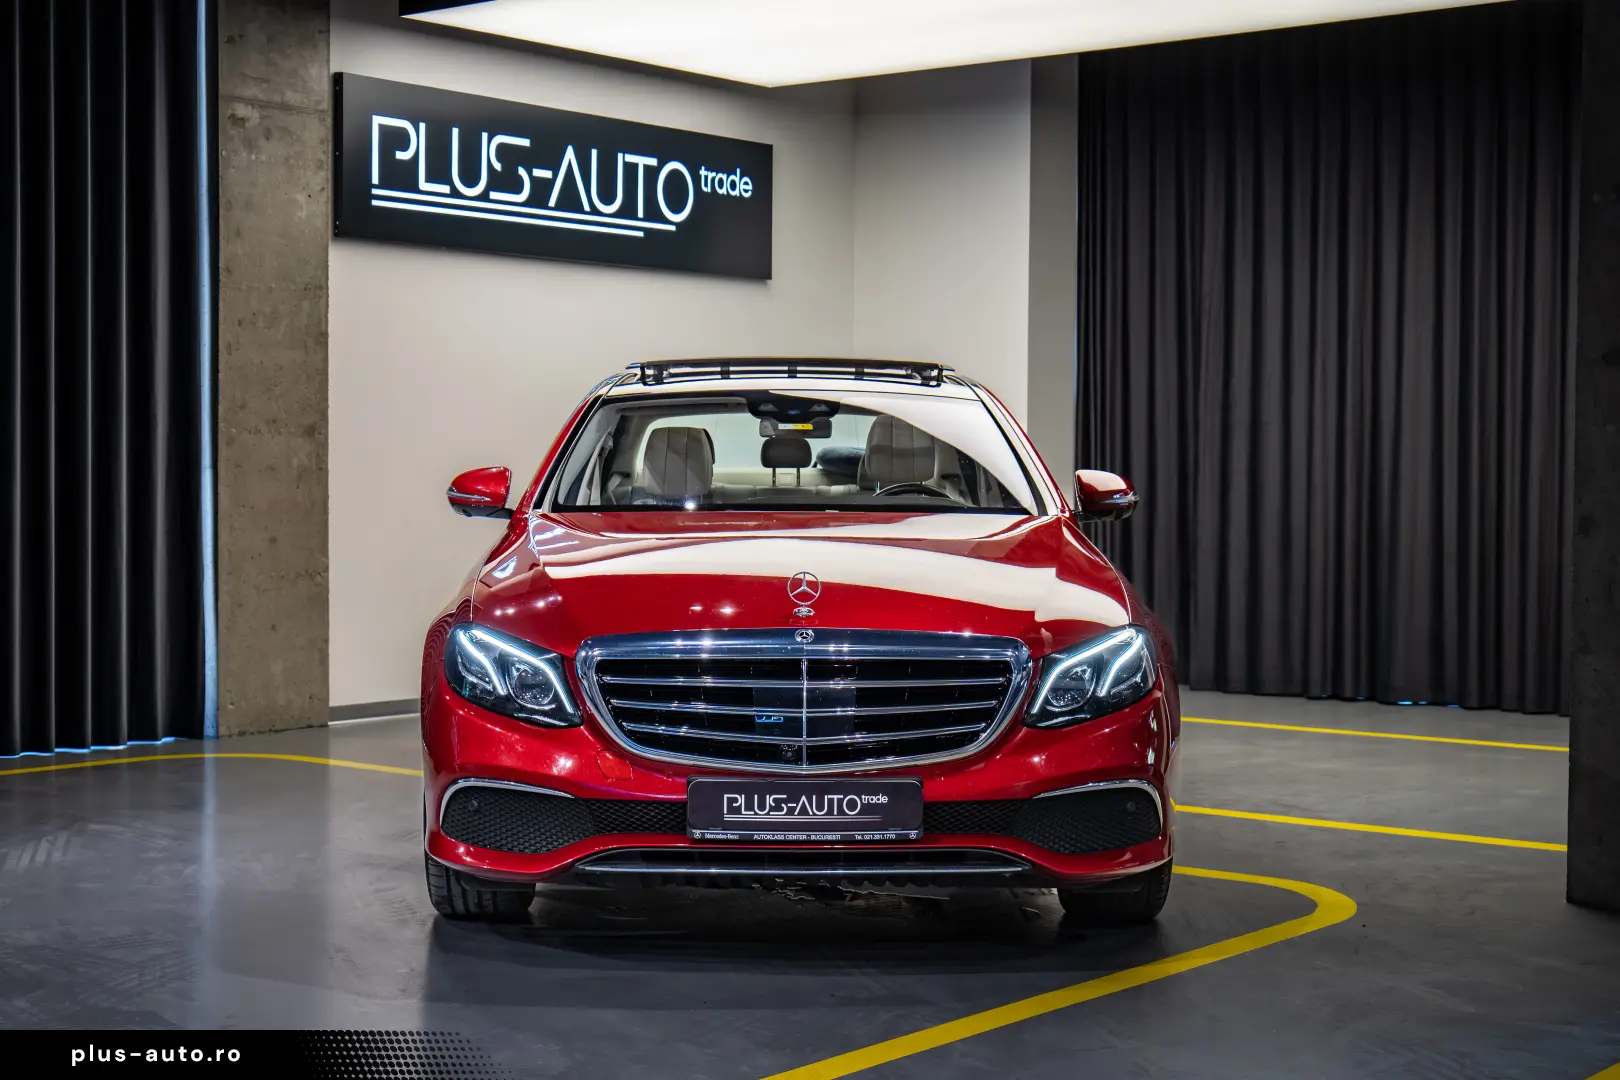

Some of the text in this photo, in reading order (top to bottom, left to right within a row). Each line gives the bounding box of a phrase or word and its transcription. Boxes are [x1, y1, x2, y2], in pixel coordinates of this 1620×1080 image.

[371, 114, 753, 223] PLUS-AUTO trade
[723, 793, 889, 815] PLUS-AUTO trade
